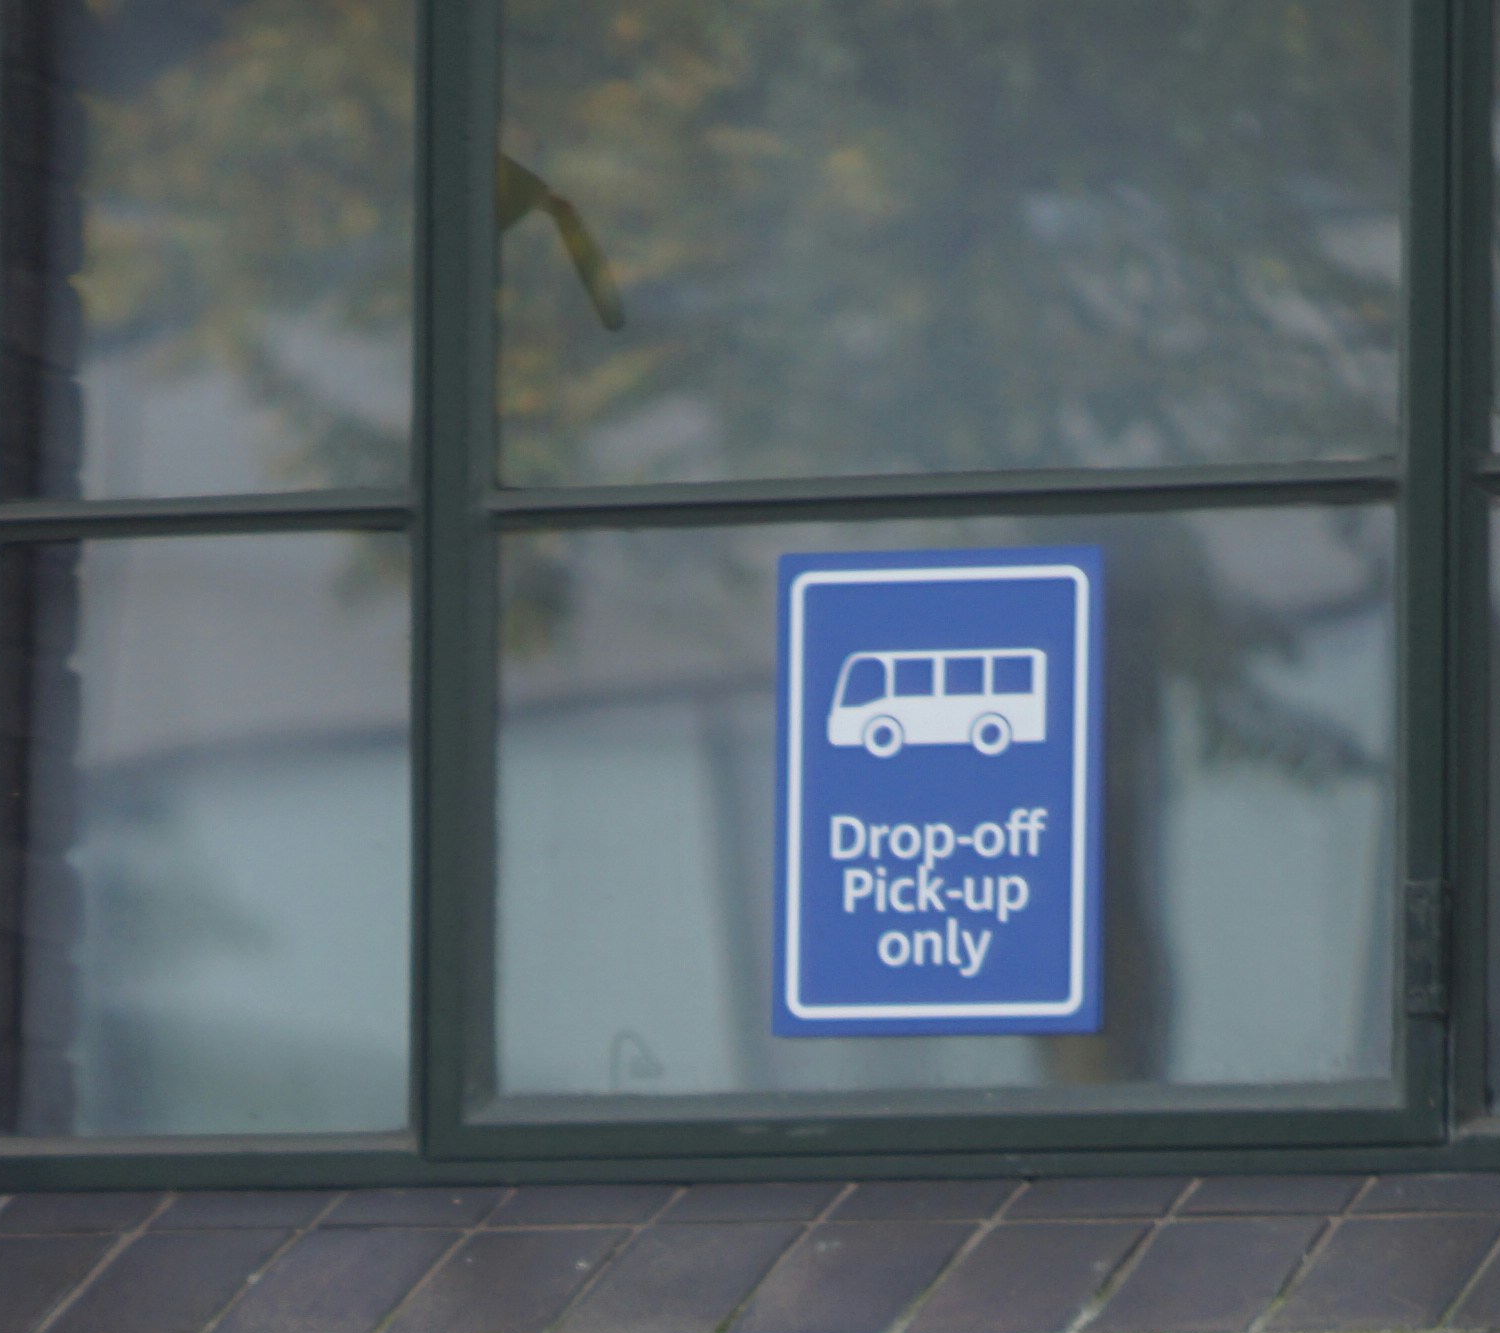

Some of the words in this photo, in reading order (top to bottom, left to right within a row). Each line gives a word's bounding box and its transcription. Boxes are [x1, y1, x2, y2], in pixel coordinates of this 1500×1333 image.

[829, 807, 1048, 868] Drop-off
[843, 864, 1029, 922] Pick-up
[877, 917, 992, 978] only
